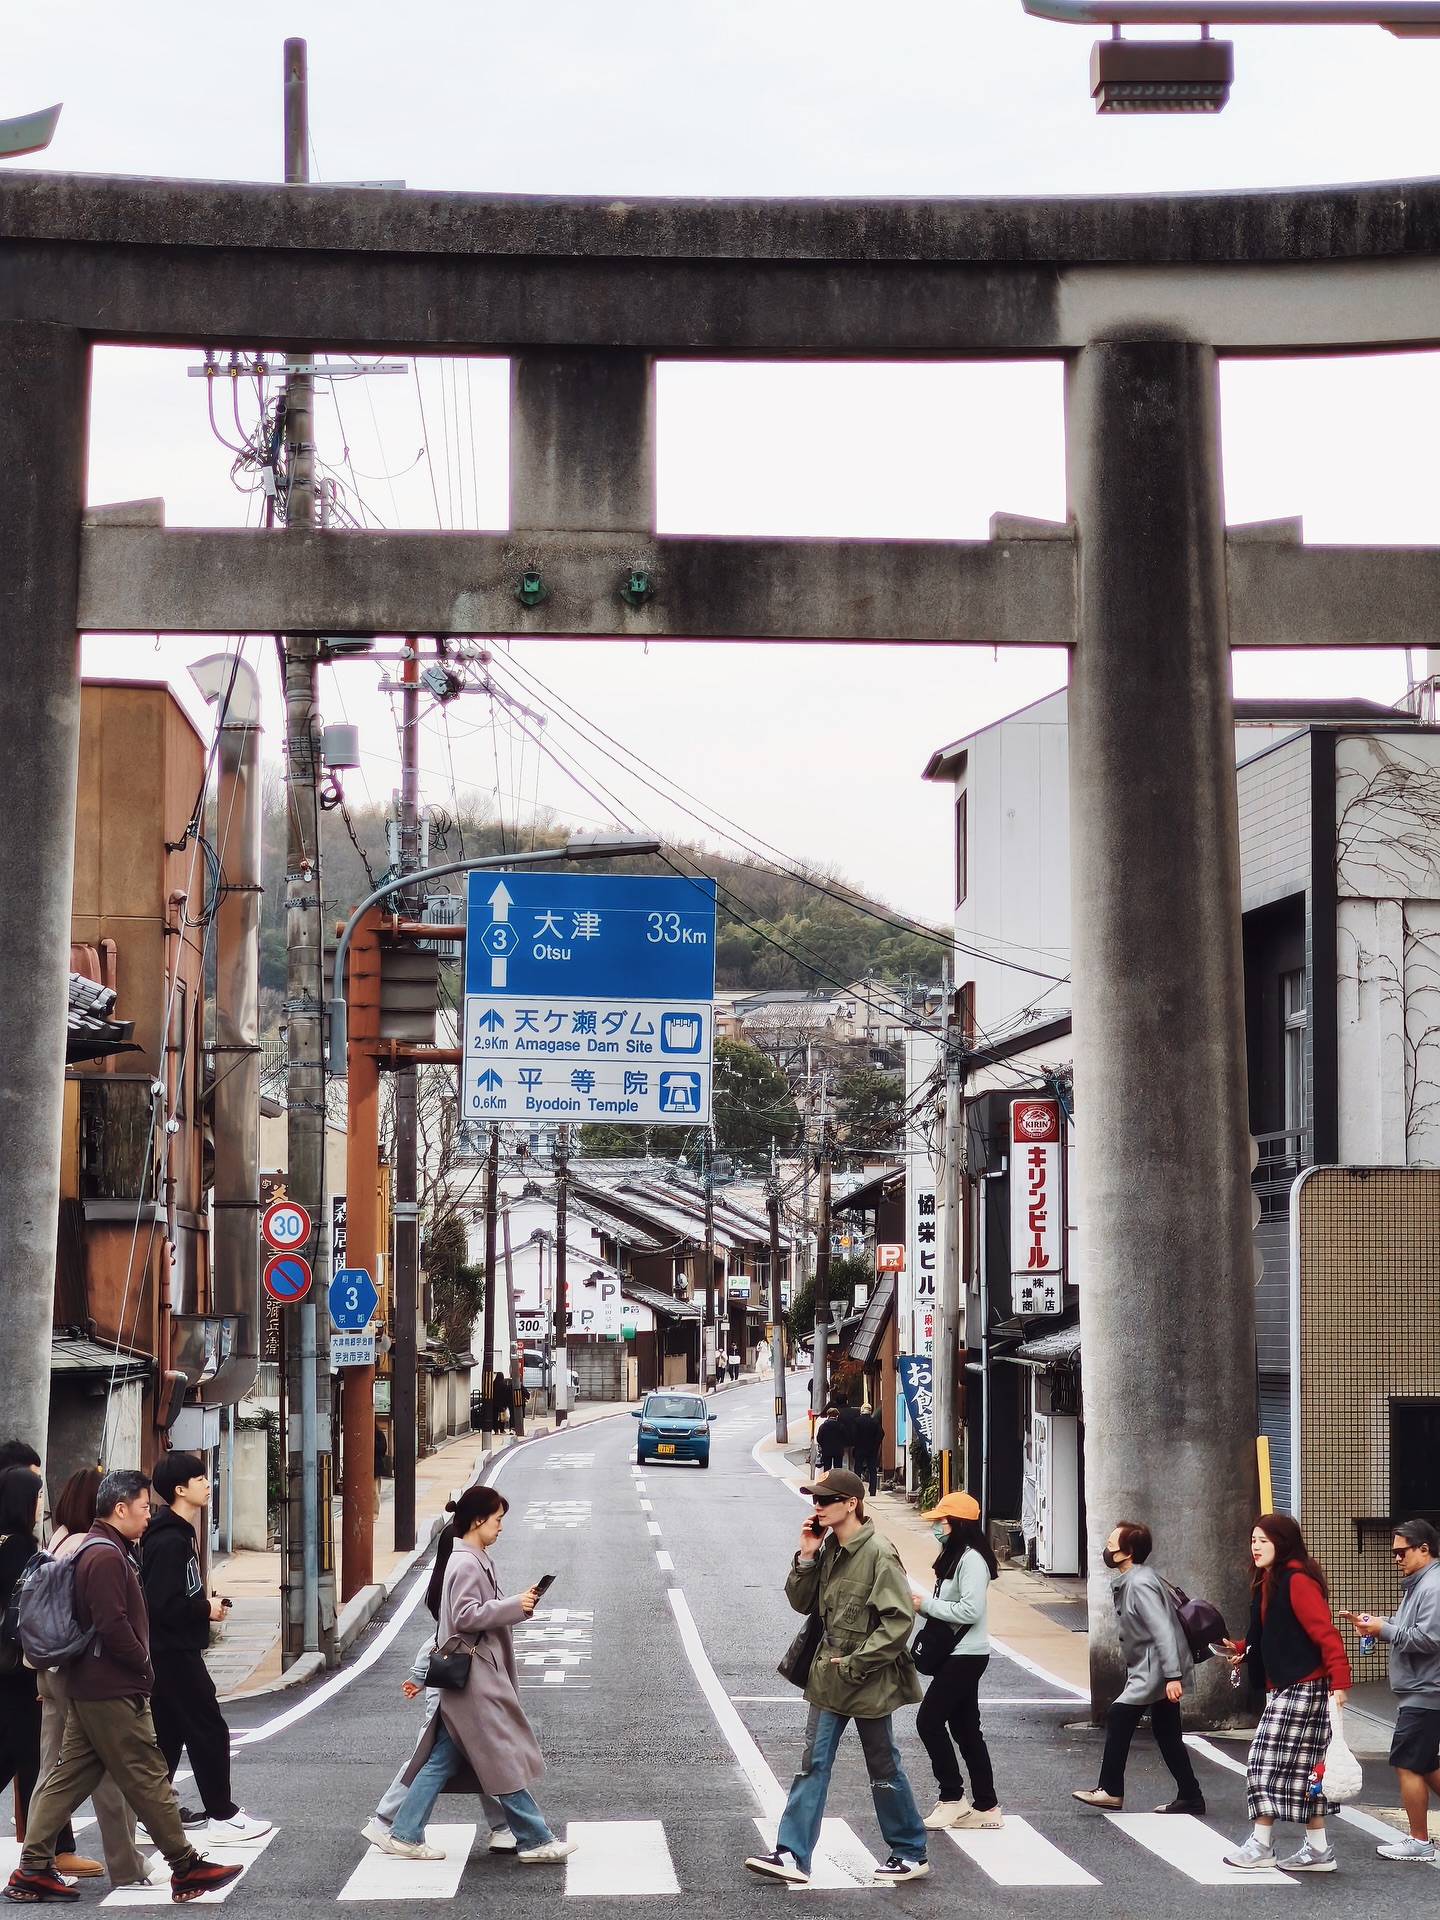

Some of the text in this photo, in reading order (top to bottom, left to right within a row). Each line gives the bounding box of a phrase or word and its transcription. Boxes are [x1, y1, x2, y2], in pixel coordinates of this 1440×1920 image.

[532, 910, 602, 941] 大津
[492, 929, 507, 950] 3
[533, 943, 571, 960] Otsu
[474, 1036, 653, 1053] 2.9Km Amagase Dam Site
[517, 1068, 649, 1095] 平等院
[473, 1095, 639, 1115] 0.6Km Byodoin Temple
[1025, 1120, 1048, 1129] KIRIN
[1028, 1146, 1050, 1268] キリンビール
[273, 1215, 300, 1237] 30
[881, 1246, 901, 1266] P
[345, 1287, 359, 1311] 3
[601, 1283, 615, 1301] P
[581, 1309, 595, 1324] P
[1022, 1300, 1055, 1313] 商店
